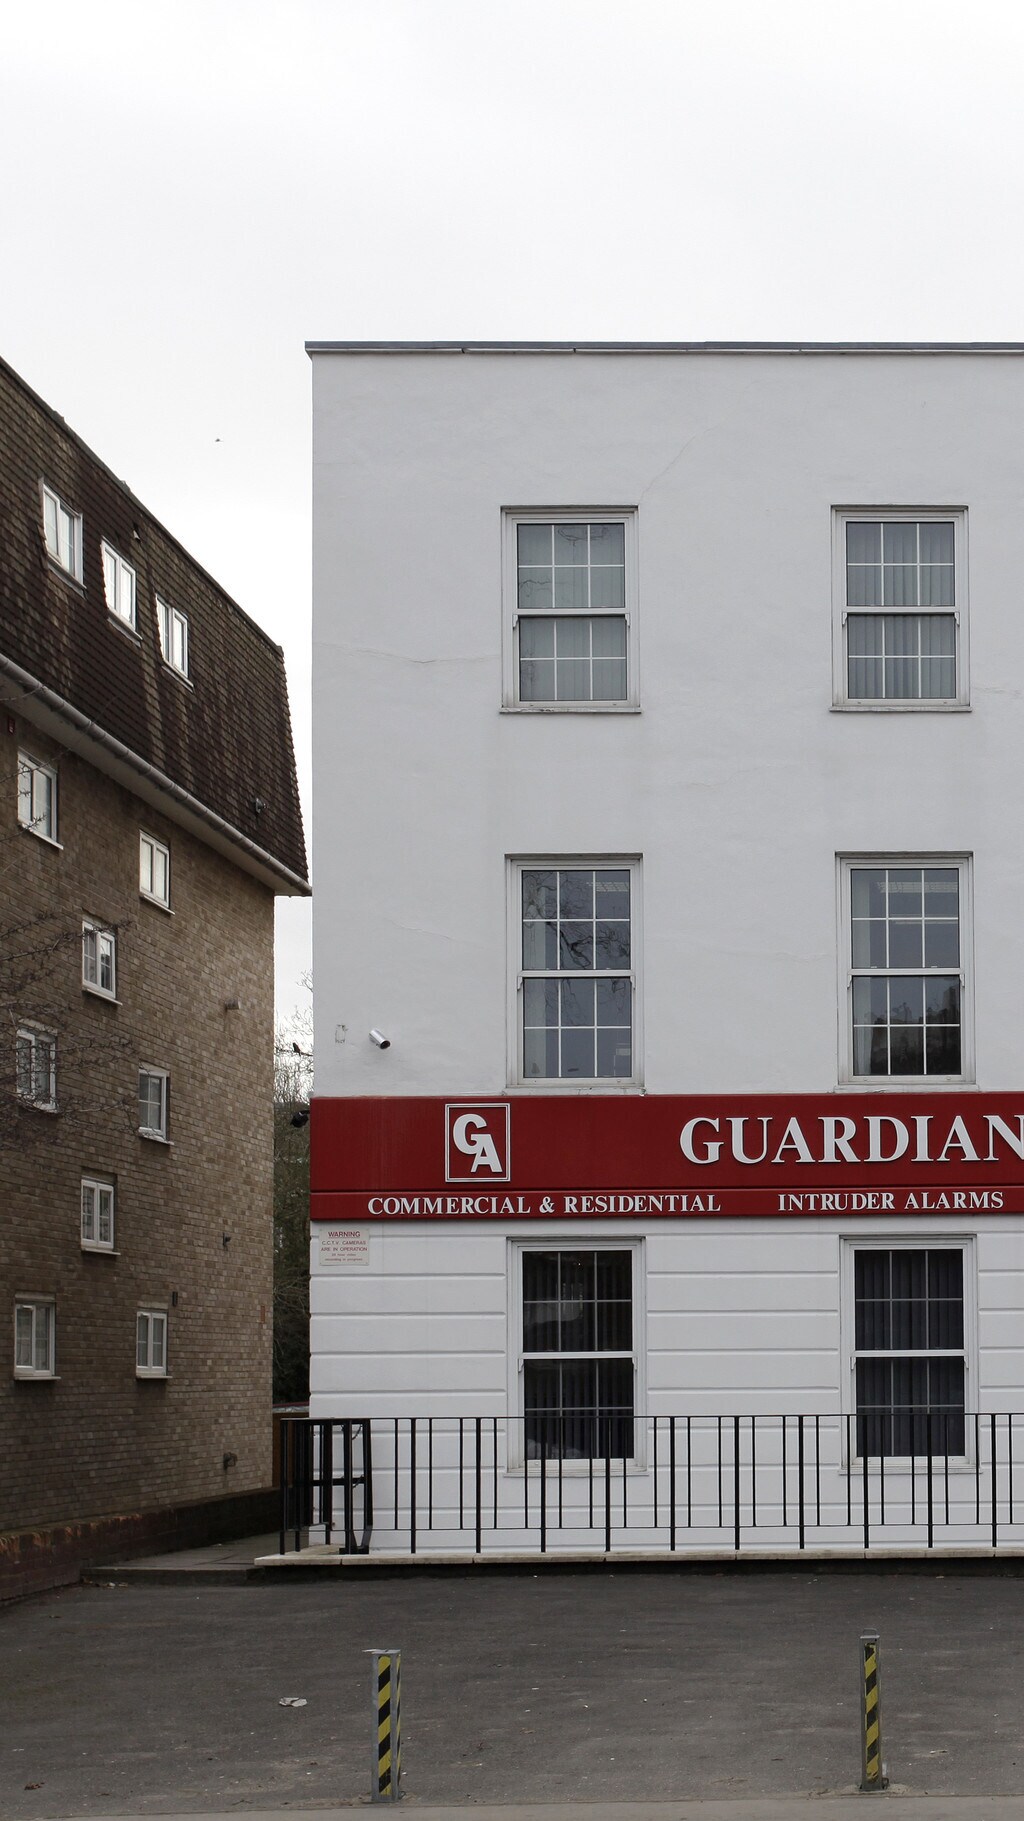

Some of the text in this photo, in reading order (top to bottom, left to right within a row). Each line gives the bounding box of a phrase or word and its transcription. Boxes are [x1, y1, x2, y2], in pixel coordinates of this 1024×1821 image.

[452, 1113, 503, 1173] GA
[367, 1193, 721, 1216] COMMERCIAL & RESIDENTIAL
[778, 1191, 1004, 1211] INTRUDER ALARMS
